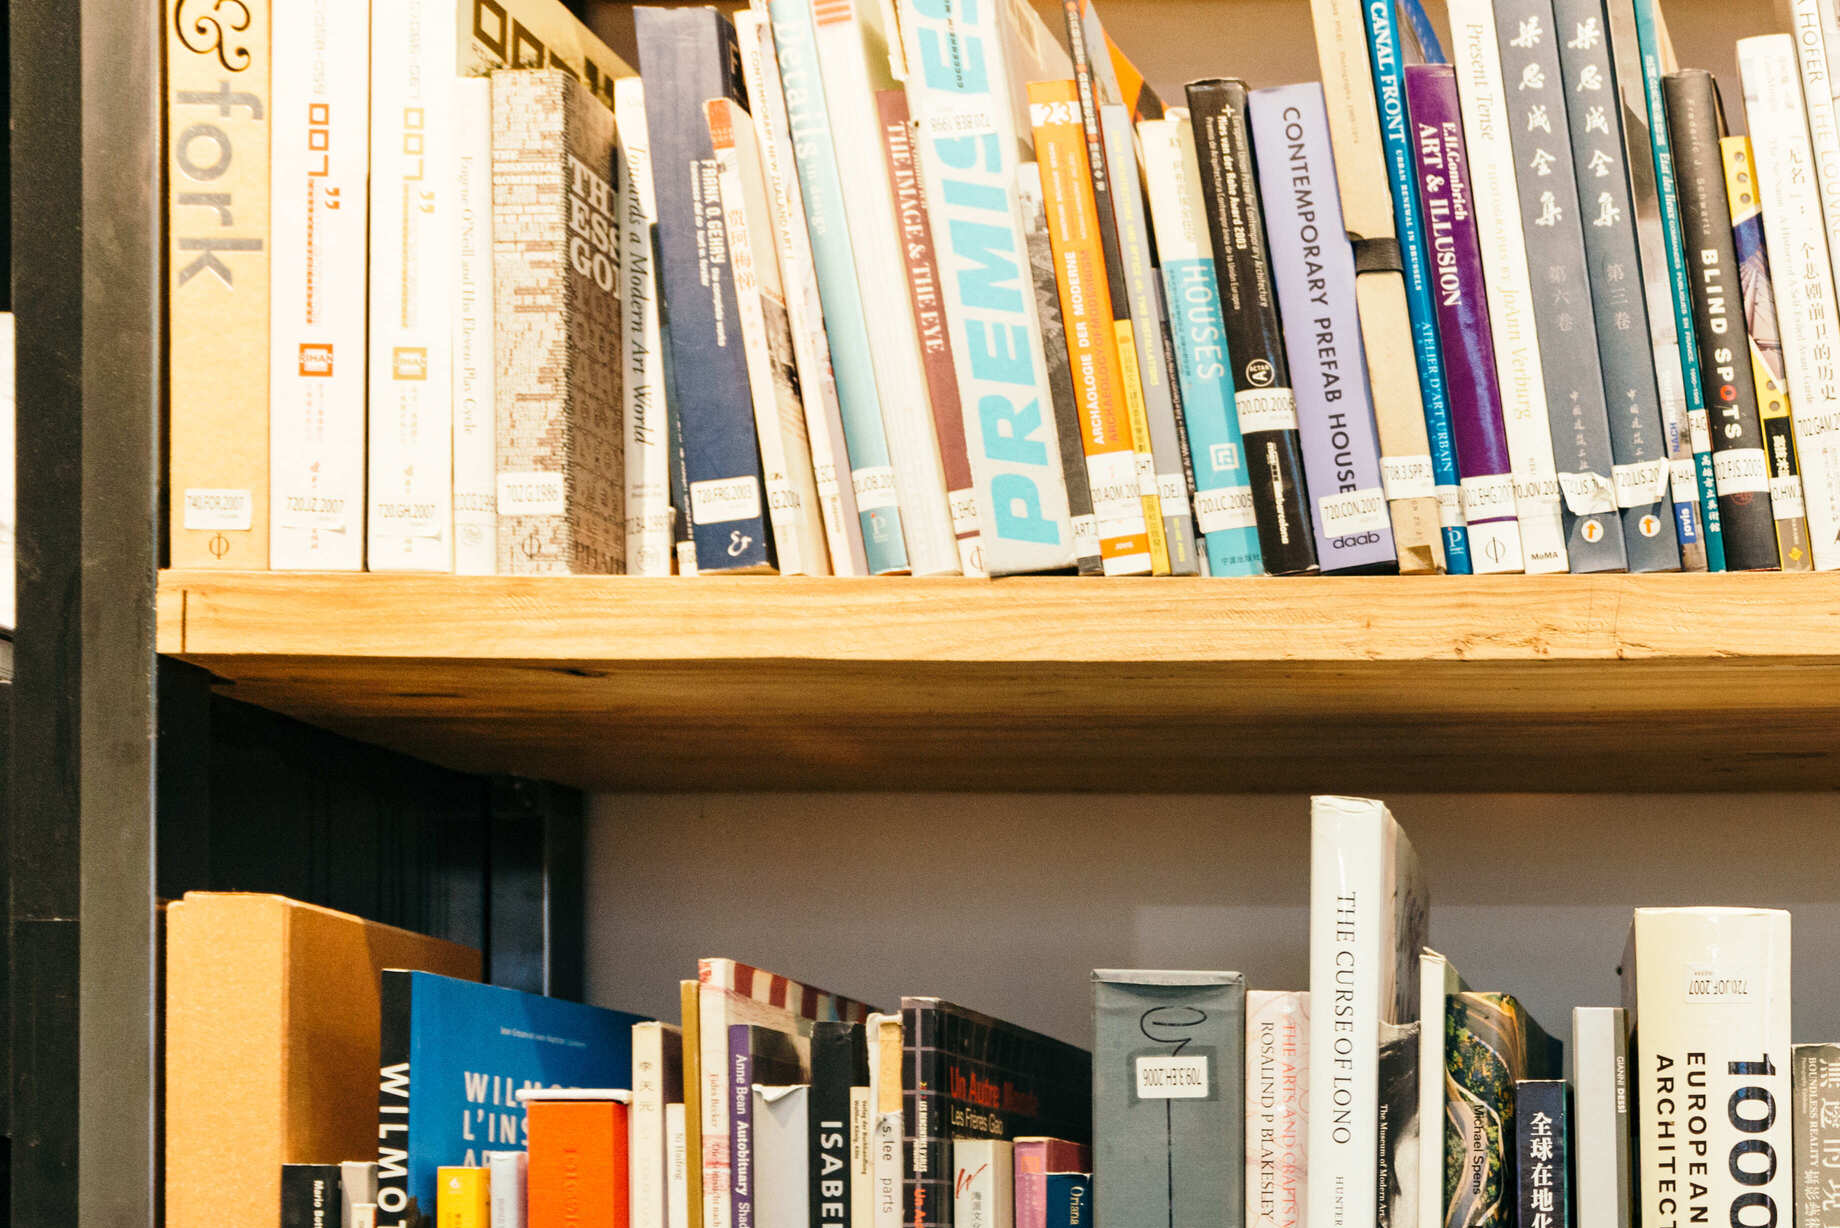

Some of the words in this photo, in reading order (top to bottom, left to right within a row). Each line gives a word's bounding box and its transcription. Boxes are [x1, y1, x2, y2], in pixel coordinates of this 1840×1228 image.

[172, 0, 254, 74] &
[1369, 0, 1397, 71] CANAL
[1378, 73, 1407, 144] FRONT
[885, 120, 909, 168] THE
[1416, 121, 1445, 171] ART
[173, 80, 266, 291] fork
[627, 143, 648, 227] Towards
[699, 158, 721, 204] FRANK
[891, 169, 922, 239] IMAGE
[1425, 174, 1445, 192] &
[628, 231, 644, 244] a
[705, 206, 723, 219] O.
[706, 219, 727, 265] GEHRY
[908, 241, 926, 259] &
[1279, 104, 1330, 307] CONTEMPORARY
[1310, 316, 1345, 405] PREFAB
[1426, 198, 1463, 308] ILLUSION
[627, 252, 650, 334] Modern
[912, 261, 936, 309] THE
[917, 310, 946, 354] EYE
[1181, 263, 1226, 381] HOUSES
[1699, 248, 1729, 335] BLIND
[1714, 348, 1742, 440] SPOTS
[630, 338, 651, 376] Art
[631, 383, 655, 448] World
[1331, 532, 1382, 552] daab
[1335, 891, 1357, 942] THE
[1333, 950, 1354, 1033] CURSE
[1333, 1037, 1354, 1070] OF
[1330, 1076, 1352, 1146] LONO
[1807, 1056, 1820, 1120] BOUNDLESS
[1685, 1051, 1709, 1226] EUROPEAN
[1808, 1121, 1819, 1168] REALITY
[313, 1179, 325, 1205] Mario
